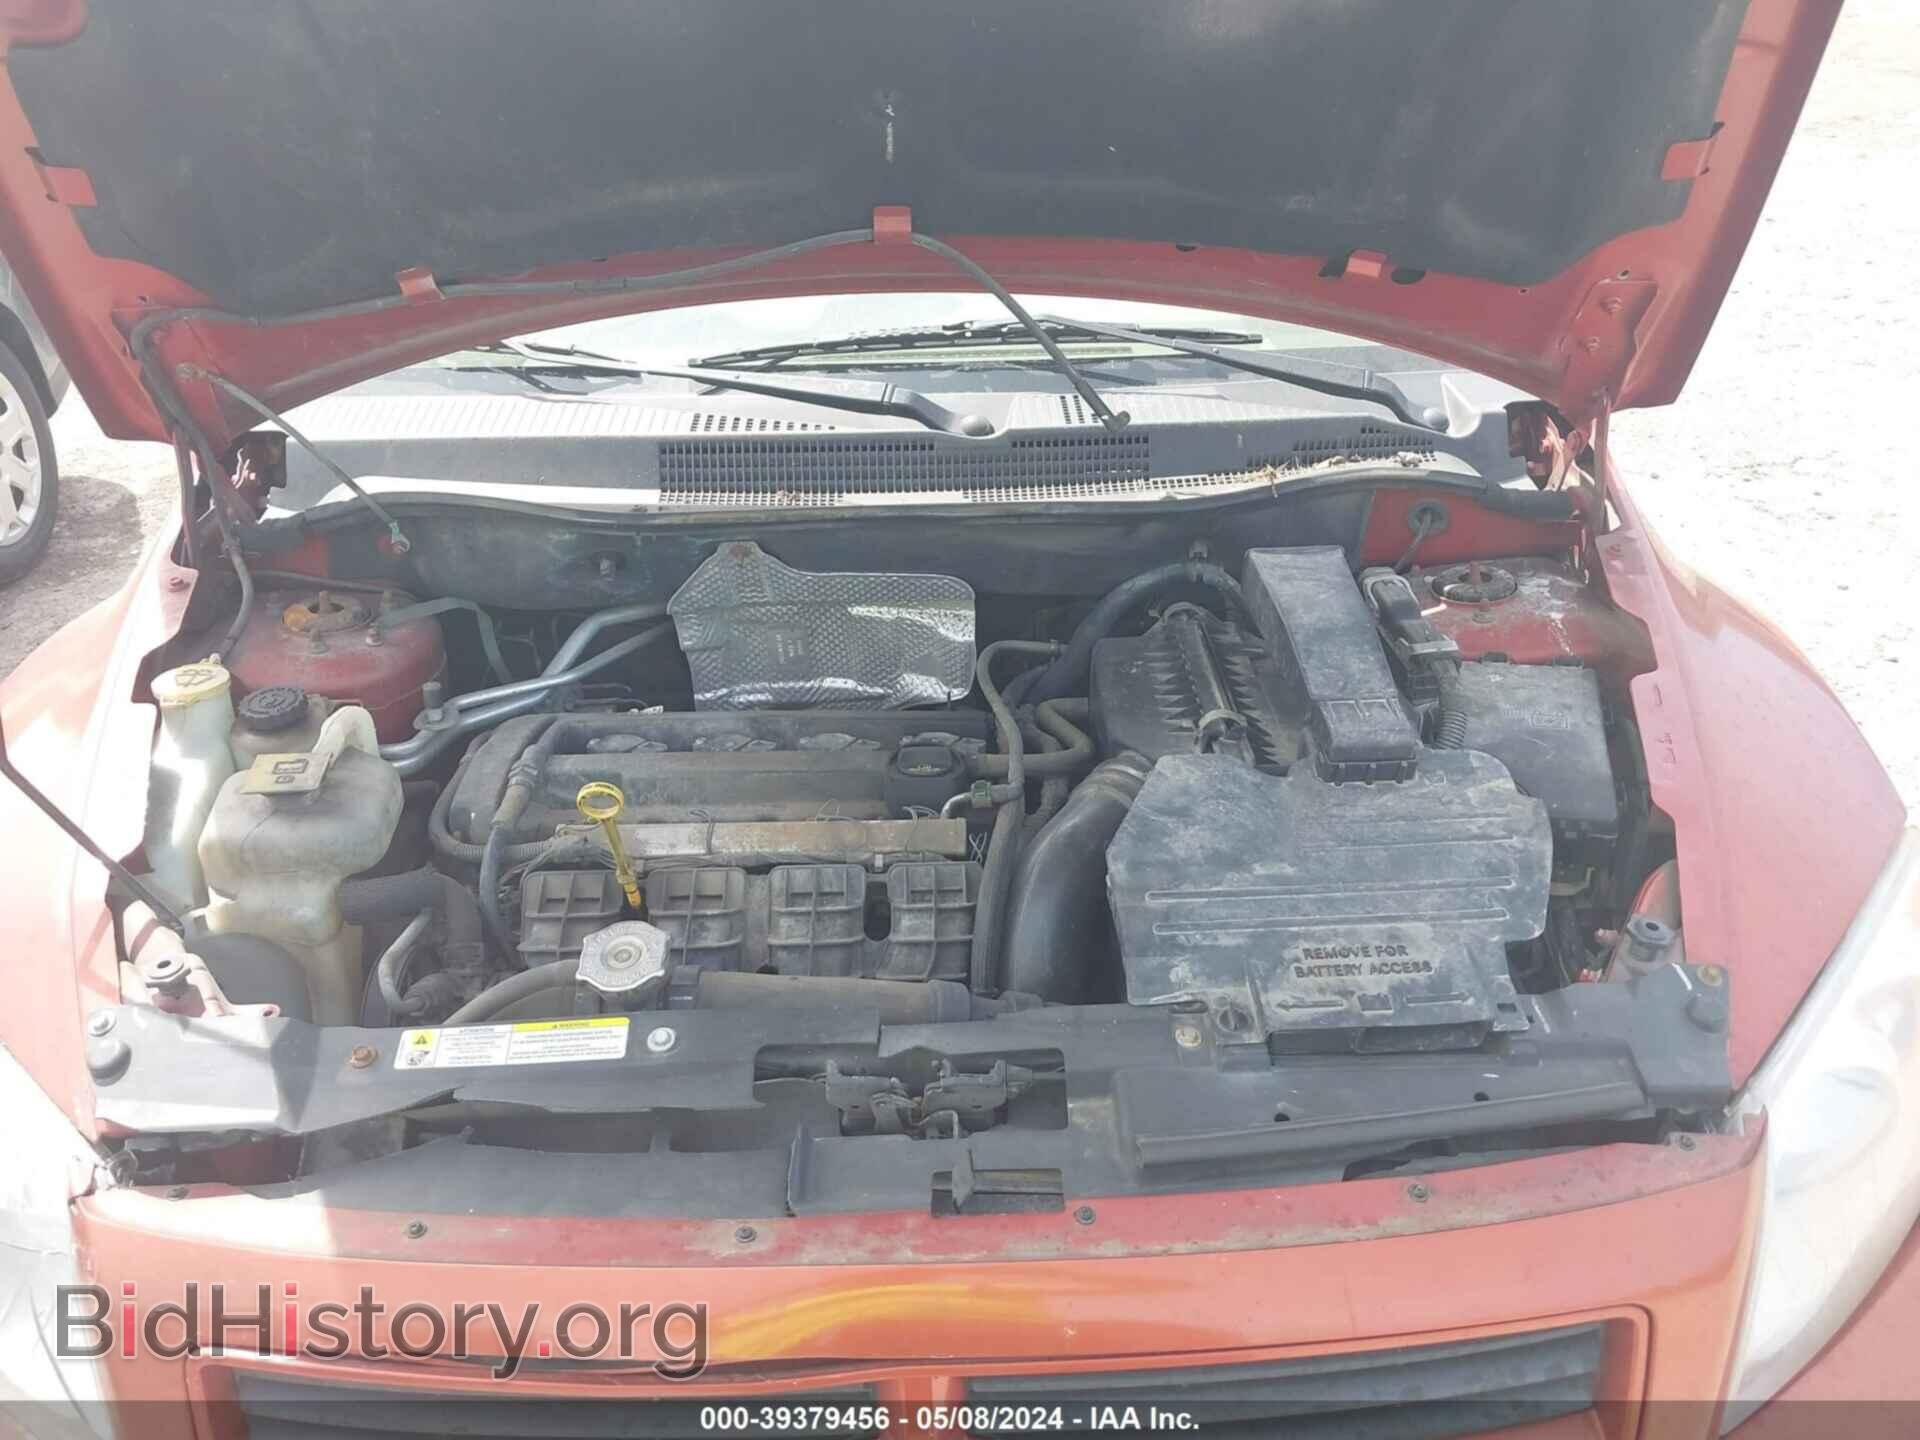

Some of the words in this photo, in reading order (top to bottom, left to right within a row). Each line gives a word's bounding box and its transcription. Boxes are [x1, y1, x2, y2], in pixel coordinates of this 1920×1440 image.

[1302, 945, 1372, 960] REMOVE
[1375, 945, 1409, 957] FOR
[1294, 963, 1363, 978] BATTERY
[1370, 960, 1433, 976] ACCESS
